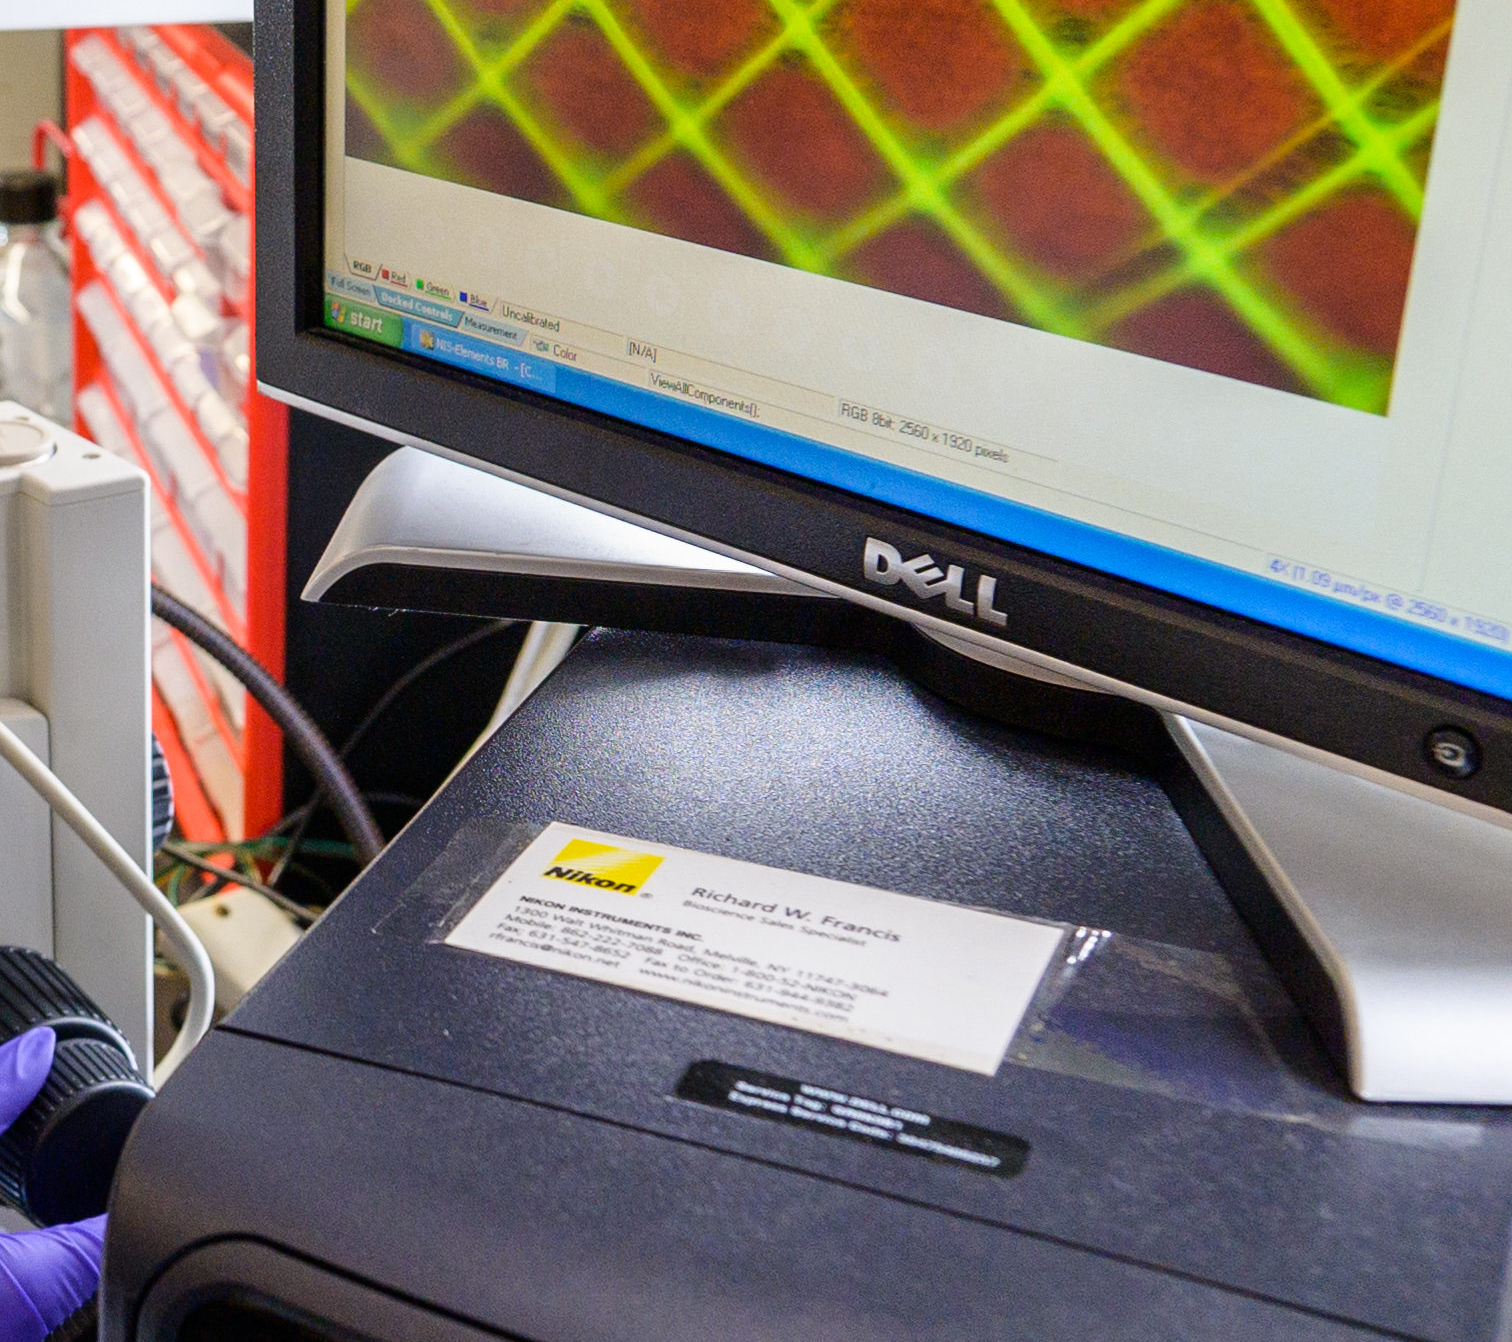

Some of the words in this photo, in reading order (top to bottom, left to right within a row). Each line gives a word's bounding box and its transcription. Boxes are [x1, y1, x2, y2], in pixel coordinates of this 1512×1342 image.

[352, 260, 372, 274] RGB
[330, 275, 346, 289] Full
[346, 281, 372, 297] Screen
[390, 270, 407, 284] Red
[426, 282, 450, 298] Green
[470, 294, 488, 308] Blue
[350, 311, 384, 334] start
[381, 291, 415, 312] Docked
[416, 300, 454, 323] Controls
[502, 300, 560, 333] Uncalibrated
[465, 316, 519, 341] Measurement
[436, 337, 495, 366] NIS-Elements
[553, 344, 578, 362] Color
[628, 341, 658, 364] [N/A]
[841, 401, 869, 422] RGB
[898, 418, 930, 441] 2560
[942, 432, 973, 454] 1920
[974, 443, 1010, 464] pixels
[863, 536, 1008, 628] DELL
[542, 865, 638, 894] Nikon
[519, 895, 566, 911] NIKON
[568, 905, 673, 935] INSTRUMENTS
[675, 928, 704, 943] INC.
[682, 899, 755, 922] Bioscience
[759, 915, 795, 931] Sales
[799, 924, 868, 948] Specialist
[691, 886, 778, 914] Richard
[784, 905, 812, 923] W.
[820, 914, 902, 944] Francis
[496, 922, 525, 937] Fax:
[644, 956, 668, 969] Fax
[673, 961, 689, 973] to
[693, 965, 739, 985] Order:
[505, 913, 555, 931] Mobile:
[677, 952, 725, 970] Office:
[514, 905, 548, 919] 1300
[553, 911, 584, 927] Walt
[589, 921, 653, 943] Whitman
[657, 937, 696, 955] Road,
[703, 948, 760, 969] Melville,
[767, 962, 793, 975] NY
[489, 931, 621, 969] rfrancis@nikon.net
[639, 967, 850, 1023] www.nikoninstruments.com
